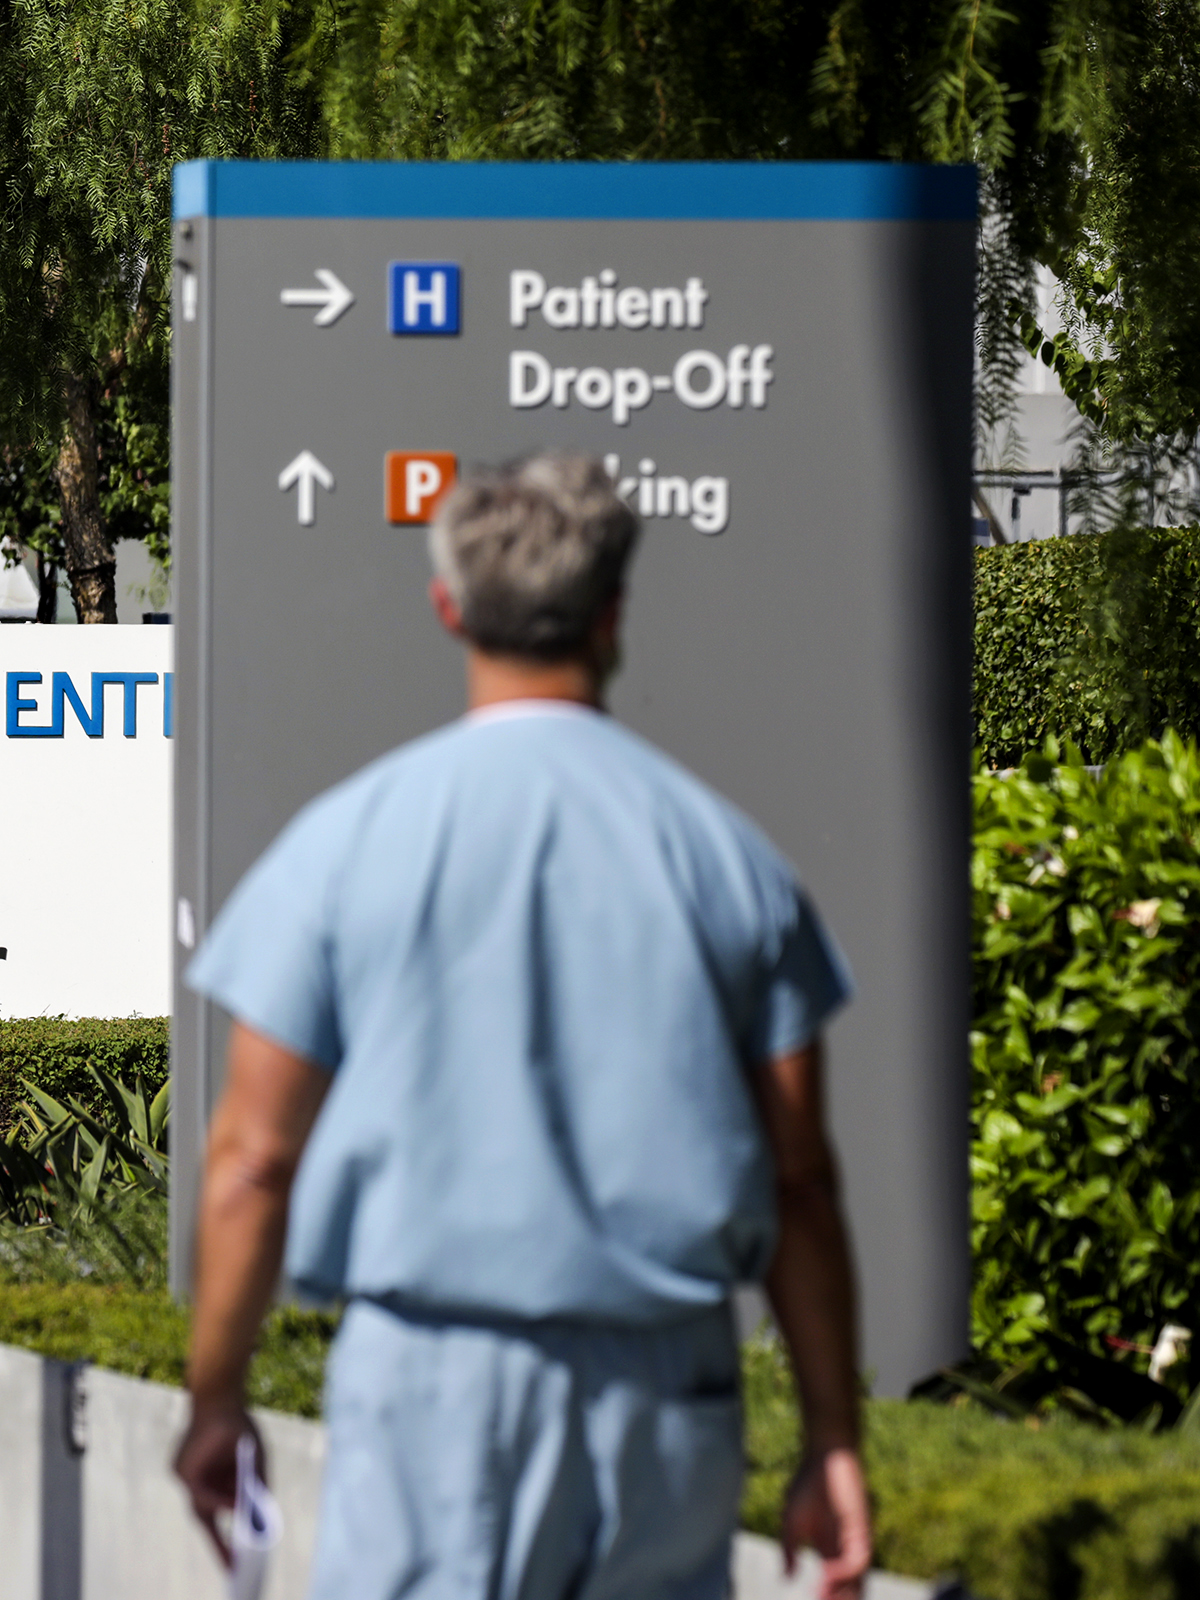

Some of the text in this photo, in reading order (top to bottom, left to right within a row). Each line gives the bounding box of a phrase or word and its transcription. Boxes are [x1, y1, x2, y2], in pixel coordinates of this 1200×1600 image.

[403, 272, 446, 326] H
[509, 268, 708, 328] Patient
[508, 344, 774, 425] Drop-Off
[404, 459, 443, 517] P
